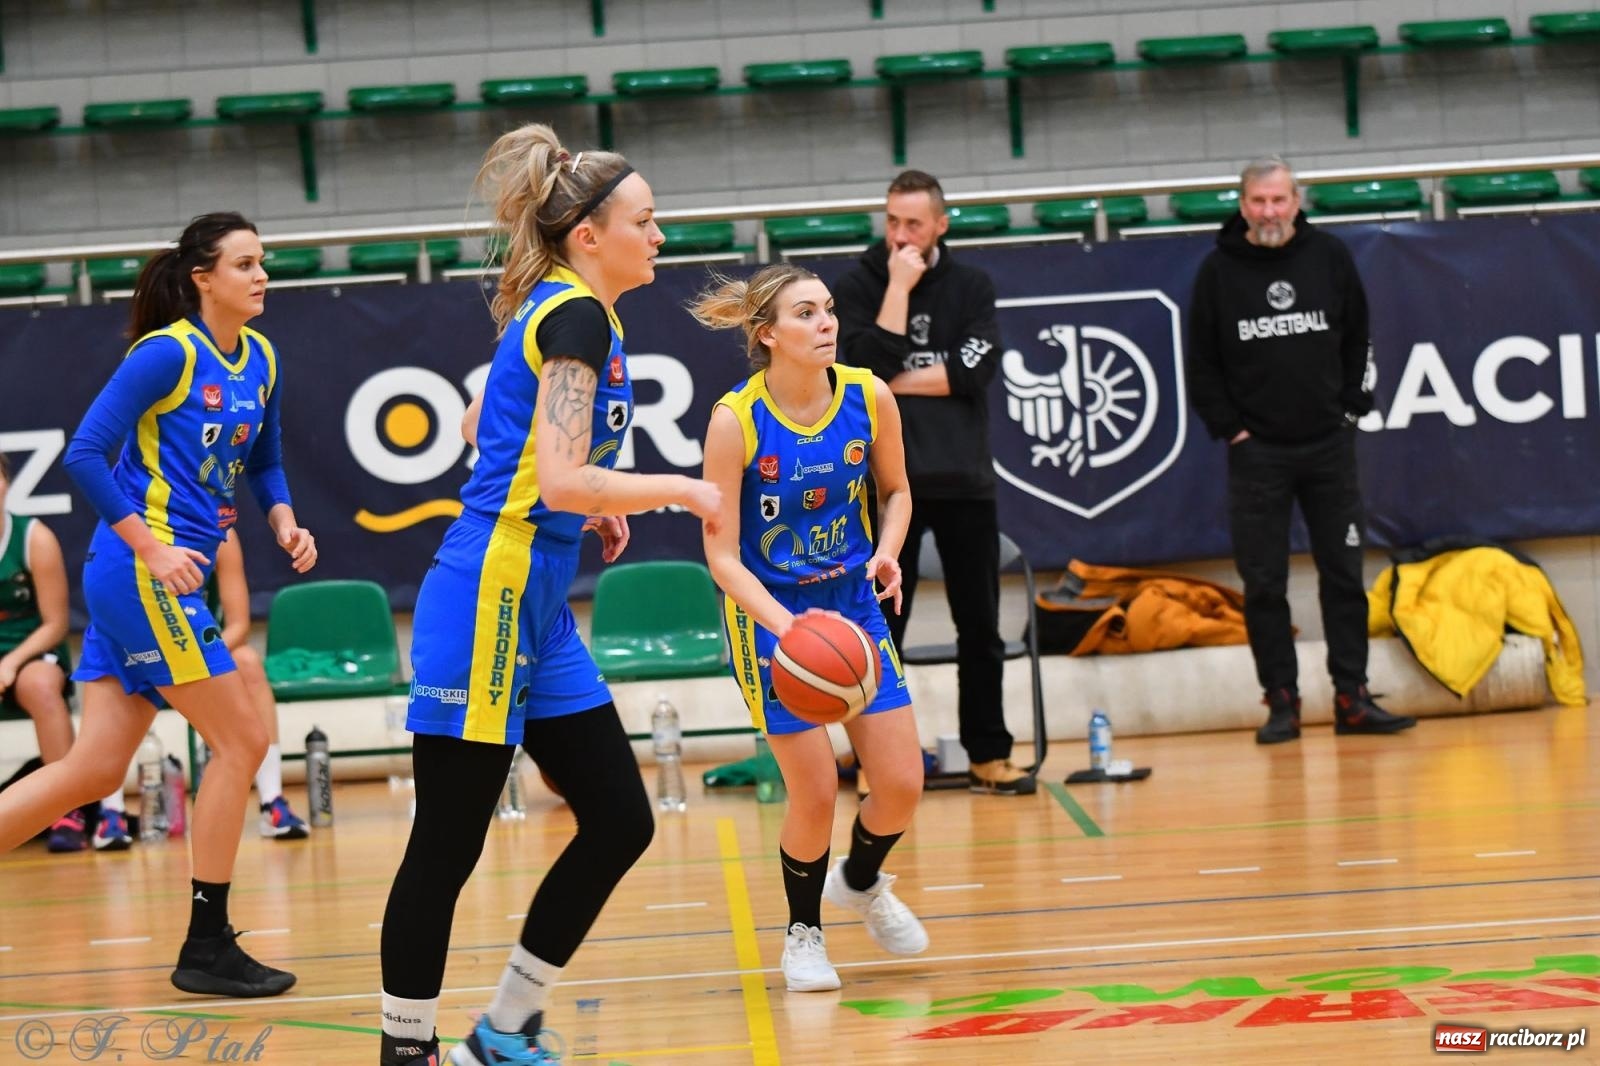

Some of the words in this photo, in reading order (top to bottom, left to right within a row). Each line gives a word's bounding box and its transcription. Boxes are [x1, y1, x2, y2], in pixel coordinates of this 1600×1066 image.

[1237, 309, 1329, 341] BASKETBALL
[1357, 333, 1600, 432] ACI
[151, 574, 189, 652] HROBRY
[489, 587, 514, 706] CHROBRY
[416, 685, 467, 699] OPOLSKIE
